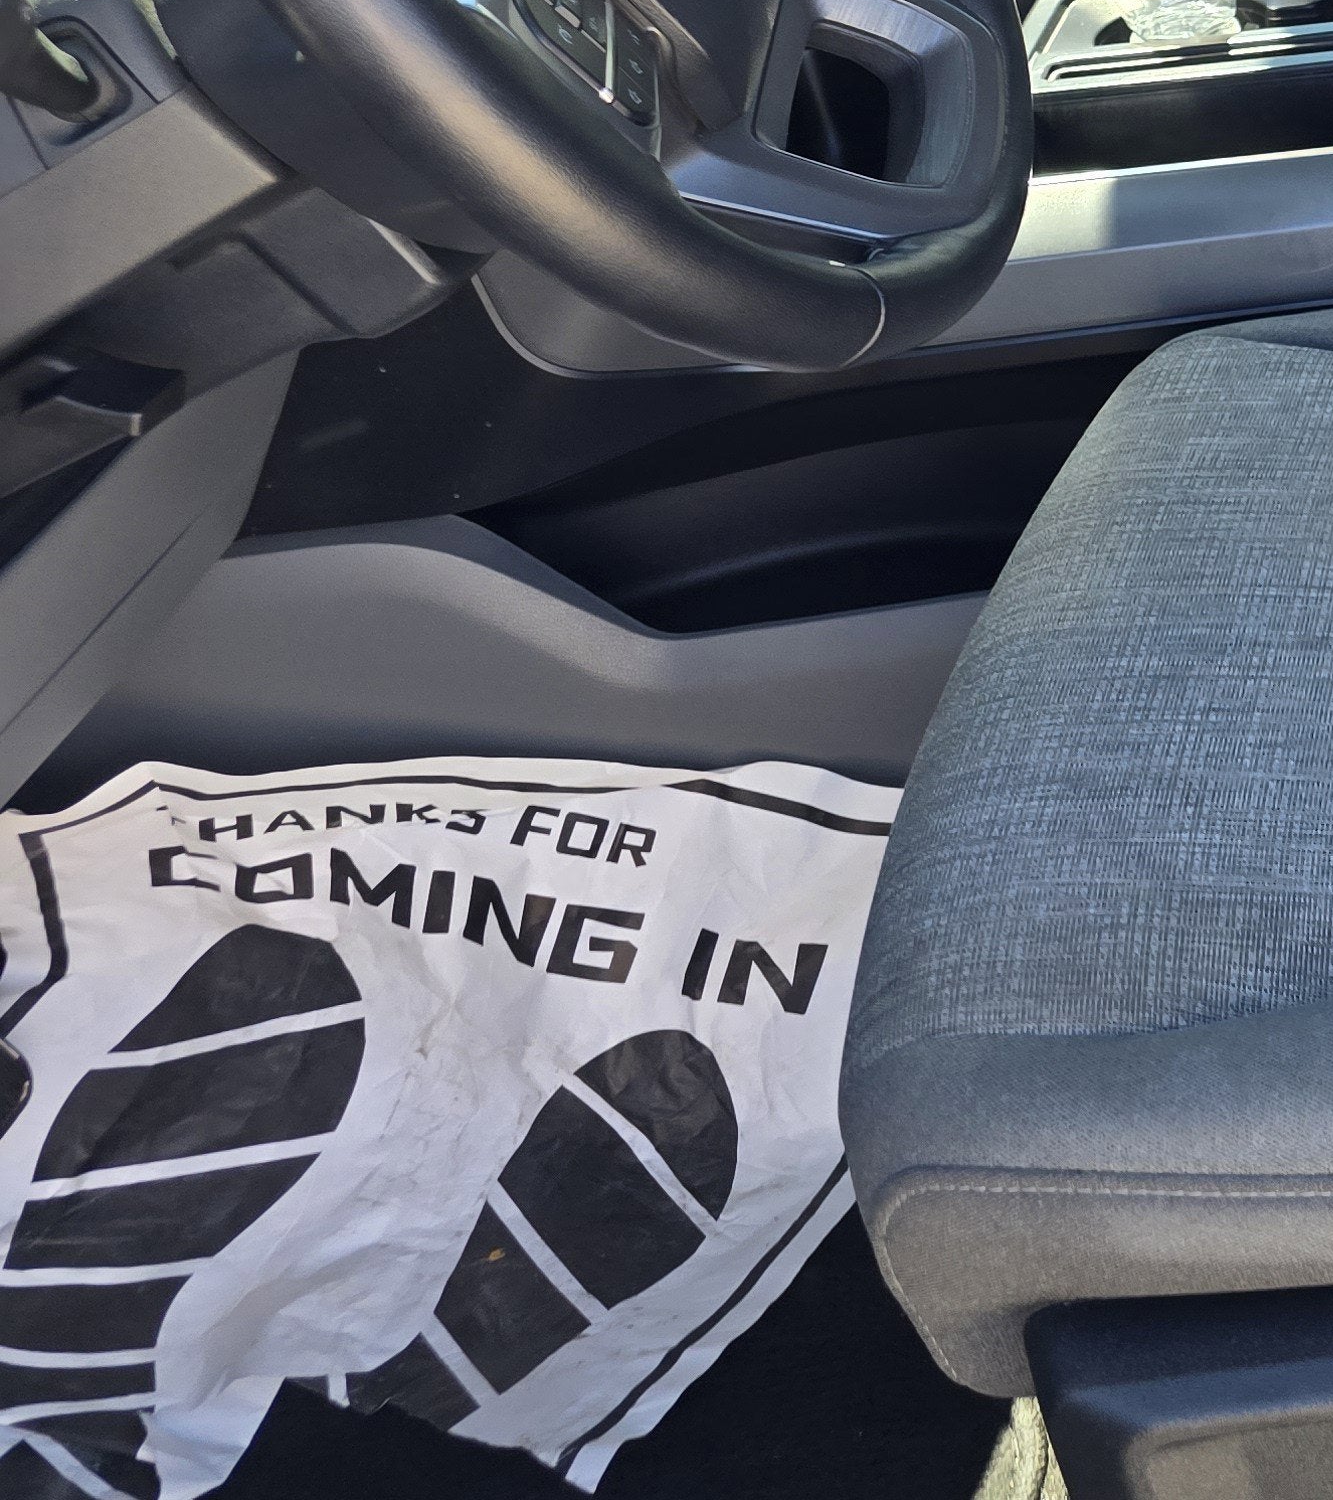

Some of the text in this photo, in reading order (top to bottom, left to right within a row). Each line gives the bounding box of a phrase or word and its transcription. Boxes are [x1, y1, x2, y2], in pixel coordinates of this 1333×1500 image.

[156, 802, 657, 867] HANKS FOR
[149, 846, 829, 1015] COMING IN
